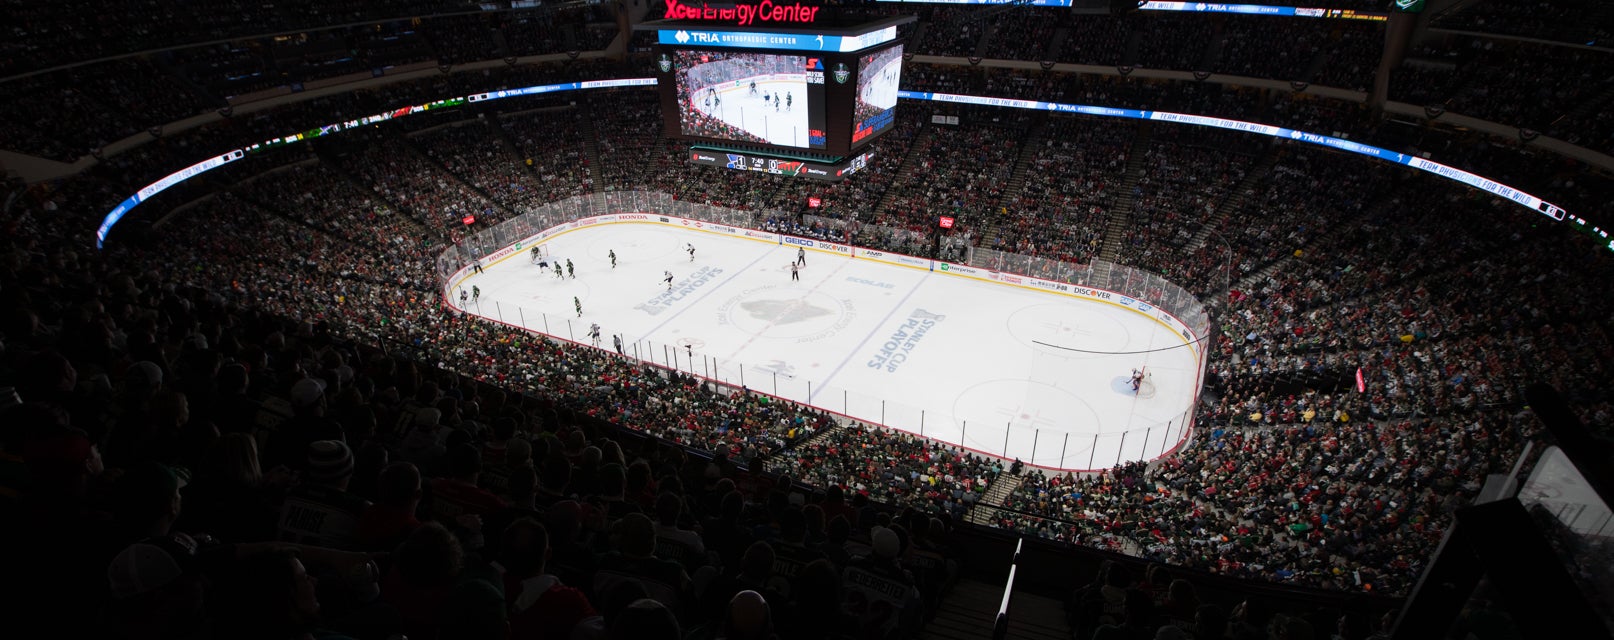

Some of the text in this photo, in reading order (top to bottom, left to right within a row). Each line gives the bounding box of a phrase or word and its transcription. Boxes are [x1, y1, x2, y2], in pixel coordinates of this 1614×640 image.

[759, 0, 819, 22] Center
[690, 32, 720, 43] TRIA
[770, 37, 796, 45] CENTER
[1249, 124, 1269, 133] WILD
[1303, 133, 1325, 144] TRIA
[1360, 145, 1381, 155] CENTER
[752, 157, 764, 165] 7:40
[1419, 160, 1438, 172] TEAM
[1482, 180, 1497, 191] FOR
[1498, 186, 1512, 198] THE
[1512, 190, 1531, 205] WILD
[785, 237, 814, 247] GEICO
[819, 242, 848, 253] DISCOVER
[488, 247, 514, 262] HONDA
[690, 265, 710, 279] CUP
[662, 267, 723, 306] PLAYOFFS
[1073, 286, 1111, 300] DISCOVER
[867, 318, 920, 370] PLAYOFFS
[886, 318, 936, 373] STANLEY CUP
[284, 503, 328, 534] PARISE
